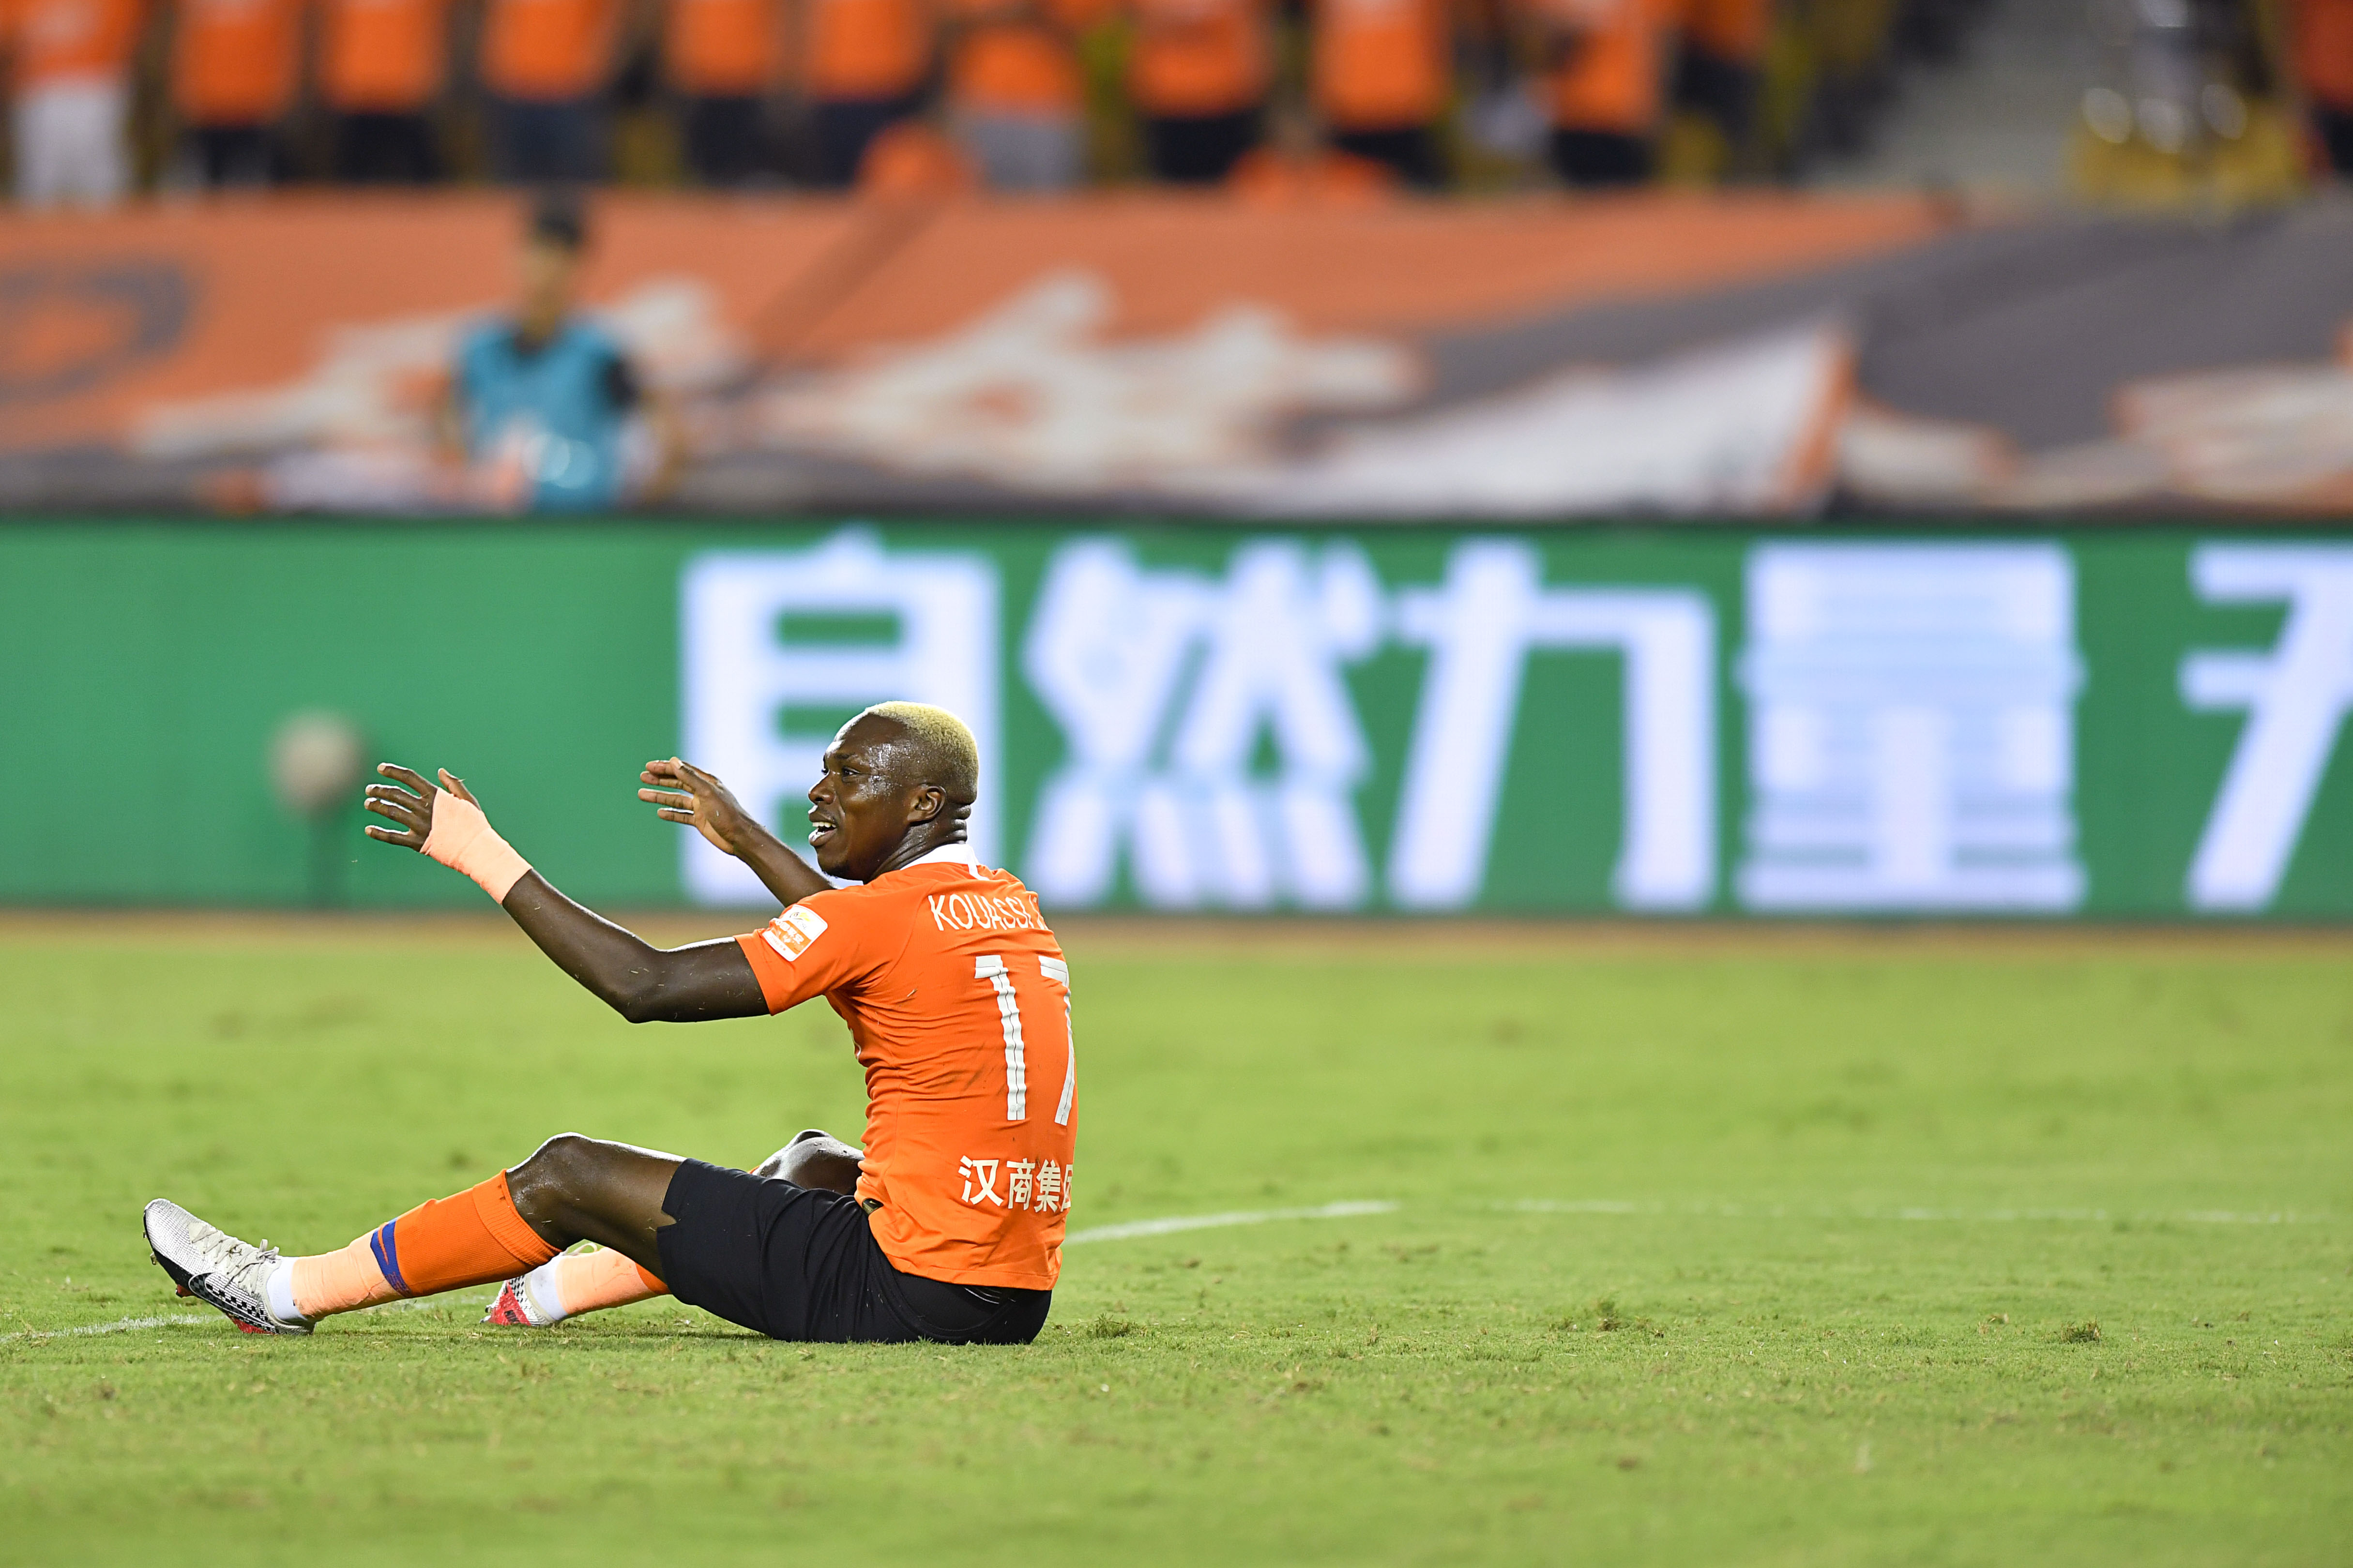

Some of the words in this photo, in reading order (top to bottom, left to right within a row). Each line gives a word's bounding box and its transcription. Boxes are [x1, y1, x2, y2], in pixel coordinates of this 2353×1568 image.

[680, 525, 2089, 914] 自然力量
[927, 894, 1034, 931] KOUASSI
[974, 955, 1076, 1126] 17
